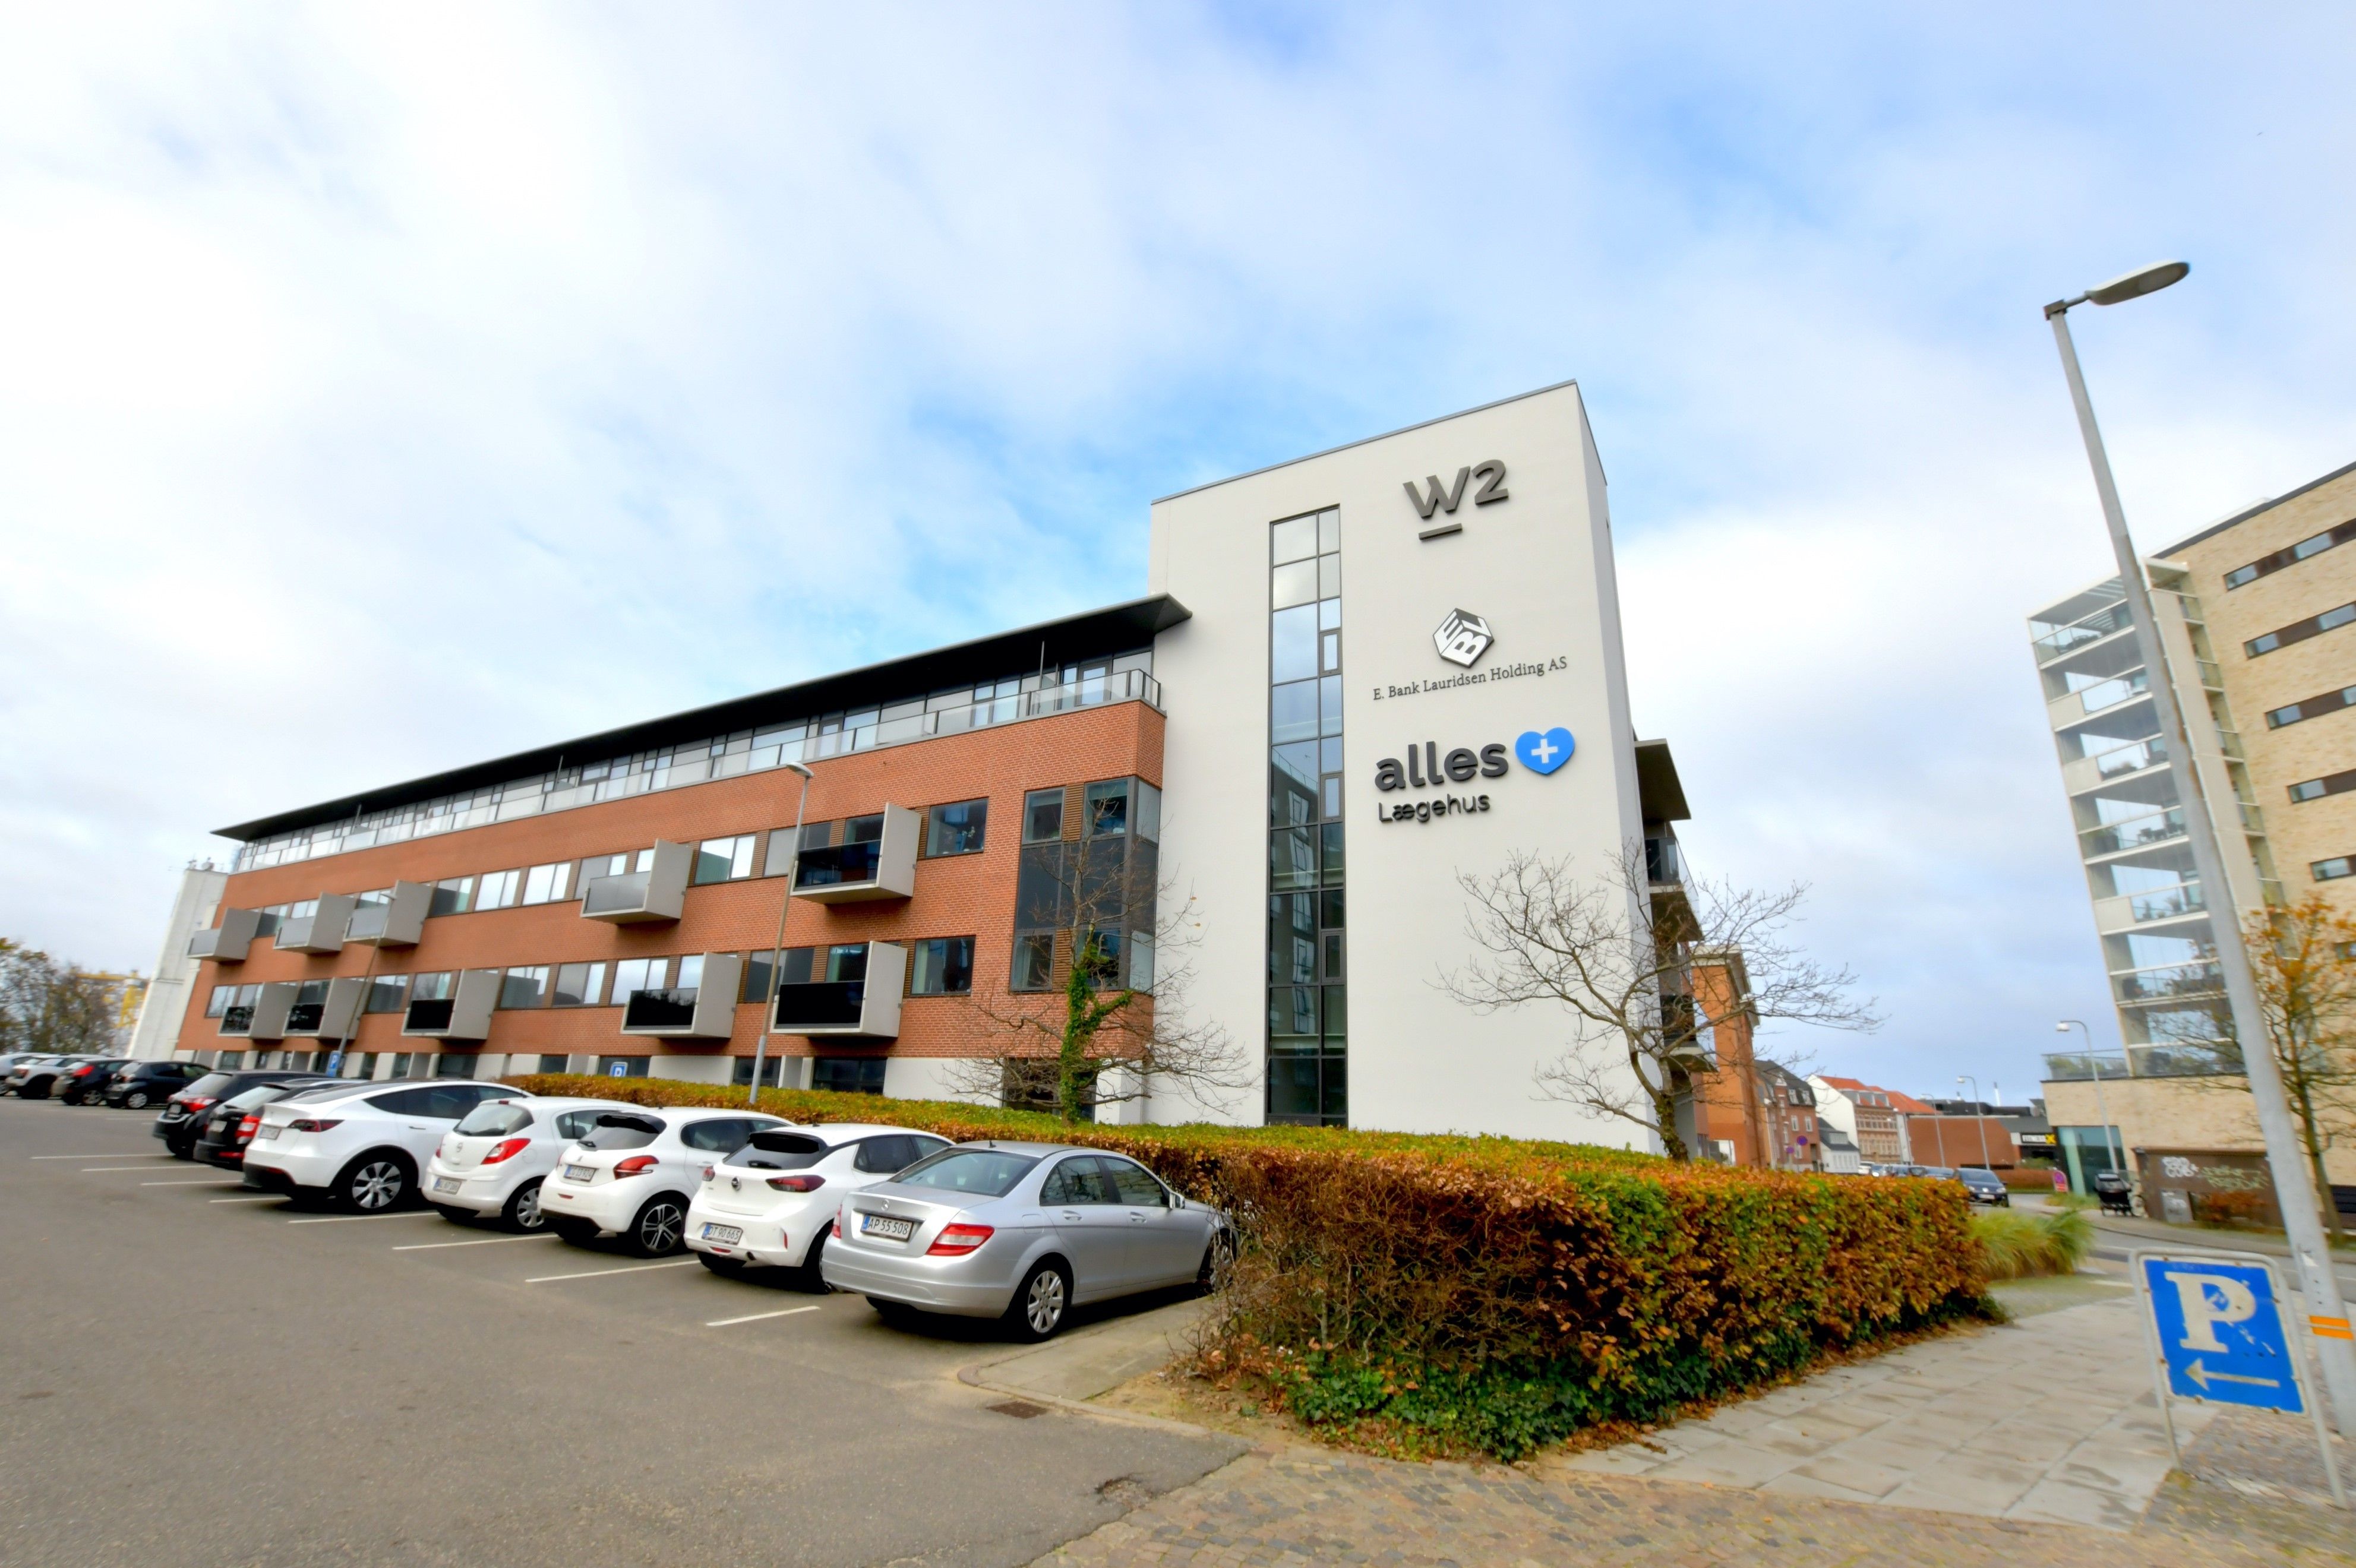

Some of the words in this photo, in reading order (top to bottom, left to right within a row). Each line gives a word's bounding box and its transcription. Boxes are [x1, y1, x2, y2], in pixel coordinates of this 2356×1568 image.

[1403, 459, 1509, 520] W2
[1373, 687, 1384, 700] E.
[1388, 682, 1420, 698] Bank
[1423, 674, 1486, 692] Lauridsen
[1490, 662, 1545, 680] Holding
[1548, 656, 1568, 671] AS
[1374, 741, 1509, 792] alles
[1378, 794, 1490, 823] Lægehus
[868, 1218, 880, 1229] AP
[880, 1220, 892, 1232] 55
[892, 1222, 909, 1235] 508
[2164, 1272, 2256, 1354] P
